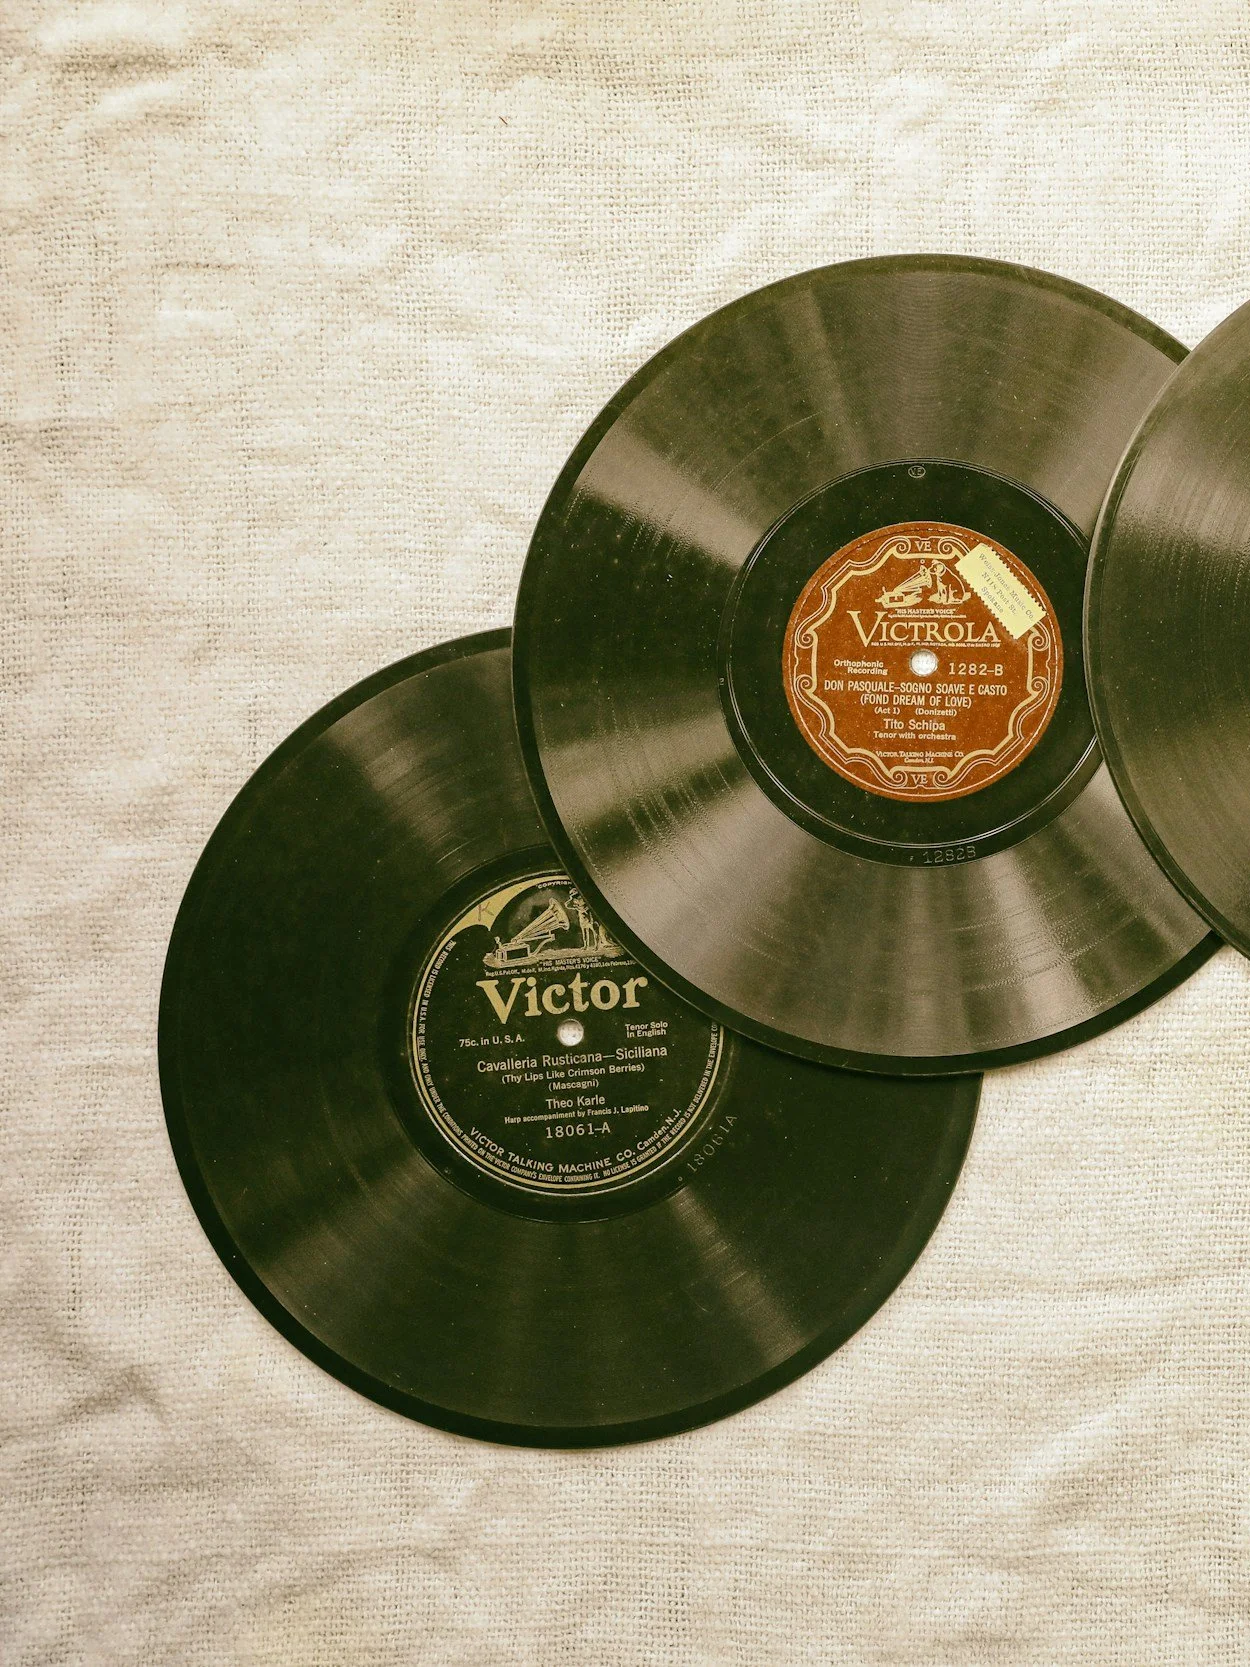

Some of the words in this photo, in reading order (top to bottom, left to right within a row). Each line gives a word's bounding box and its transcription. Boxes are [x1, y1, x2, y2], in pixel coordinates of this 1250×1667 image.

[915, 540, 932, 551] VE
[981, 586, 1004, 614] Spokane
[1010, 590, 1026, 610] Music
[847, 610, 1001, 648] VICTROLA
[833, 659, 884, 668] Orthophonic
[847, 666, 888, 676] Recording
[824, 680, 844, 691] DON
[936, 683, 965, 695] SOAVE
[969, 684, 975, 695] E
[977, 684, 1007, 696] CASTO
[860, 694, 889, 706] (FOND
[893, 695, 926, 707] DREAM
[929, 696, 942, 707] OF
[945, 696, 972, 708] LOVE)
[874, 706, 891, 715] (Act
[892, 706, 901, 715] 1)
[915, 707, 957, 717] (Donizetti)
[883, 718, 904, 730] Tito
[908, 719, 946, 732] Schipa
[873, 732, 897, 740] Tenor
[898, 732, 916, 740] with
[918, 733, 956, 741] orchestra
[911, 774, 928, 784] VE
[476, 972, 649, 1025] Victor
[625, 1022, 648, 1031] Tenor
[650, 1020, 668, 1030] Solo
[636, 1028, 667, 1038] English
[459, 1038, 479, 1048] 75c.
[480, 1036, 490, 1046] in
[477, 1056, 538, 1073] Cavalleria
[501, 1073, 522, 1085] (Thy
[524, 1072, 544, 1083] Lips
[546, 1069, 565, 1079] Like
[567, 1066, 606, 1077] Crimson
[609, 1062, 646, 1074] Berries)
[548, 1079, 600, 1092] (Mascagni)
[545, 1098, 574, 1110] Theo
[577, 1094, 606, 1107] Karle
[504, 1115, 522, 1125] Harp
[522, 1110, 576, 1122] accompaniment
[577, 1109, 586, 1118] by
[587, 1107, 612, 1117] Francis
[613, 1106, 620, 1114] J.
[470, 1126, 505, 1157] VICTOR
[508, 1151, 554, 1173] TALKING
[558, 1157, 612, 1174] MACHINE
[616, 1149, 636, 1162] CO.
